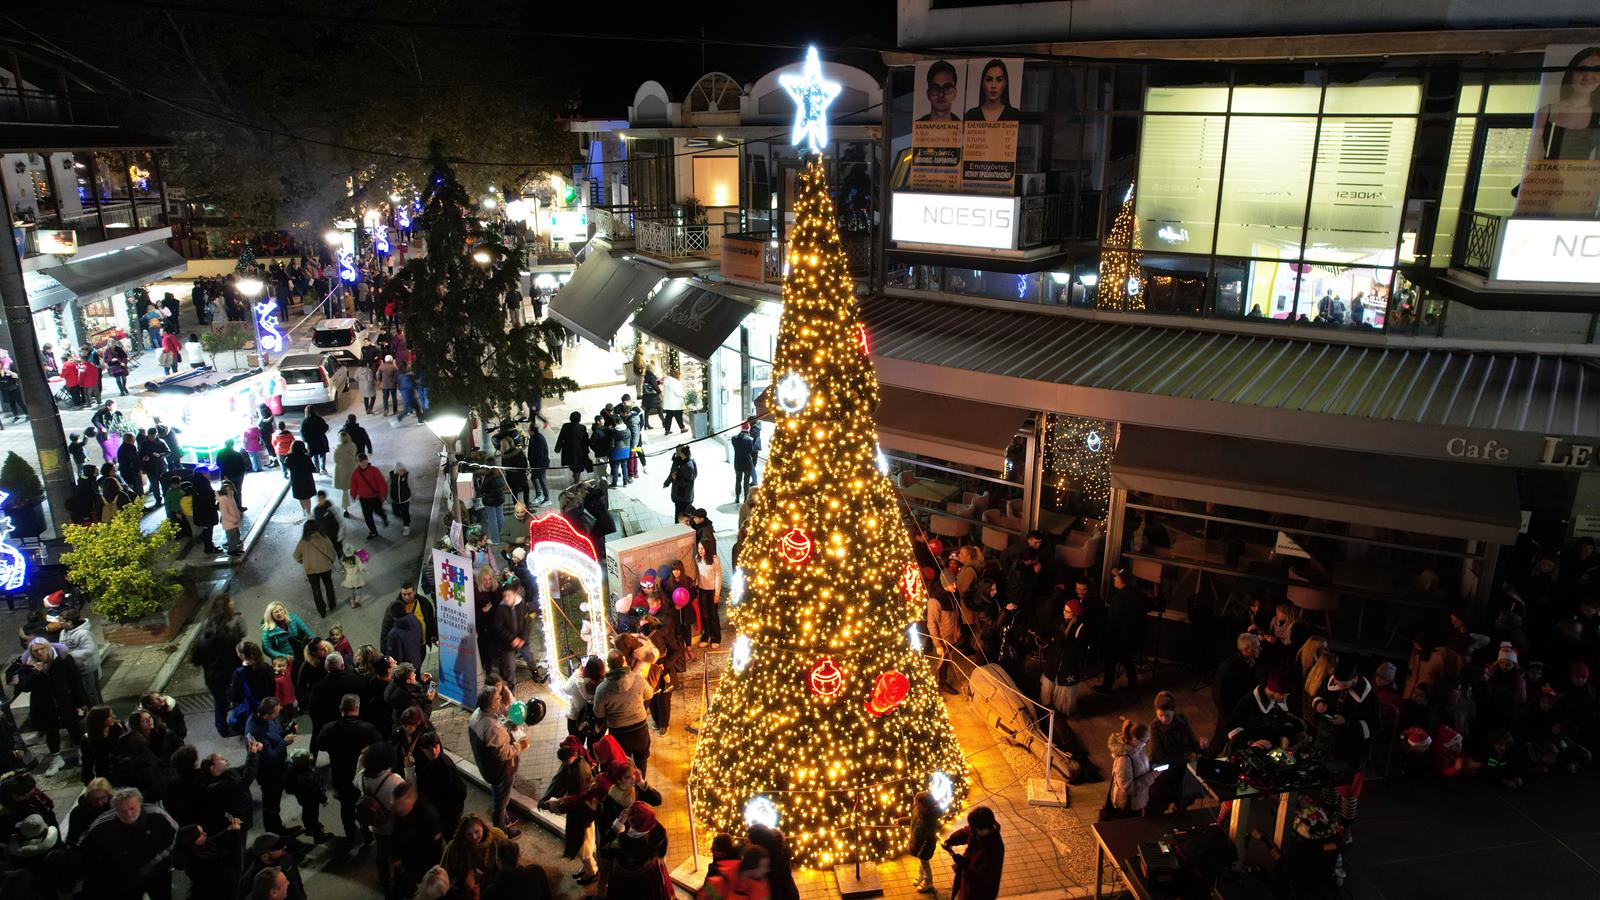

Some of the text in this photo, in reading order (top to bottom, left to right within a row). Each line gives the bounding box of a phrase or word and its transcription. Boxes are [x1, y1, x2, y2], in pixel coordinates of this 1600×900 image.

[969, 162, 1009, 172] Επιτυχόντες
[923, 205, 1011, 229] NOESIS
[1446, 437, 1510, 461] Cafe
